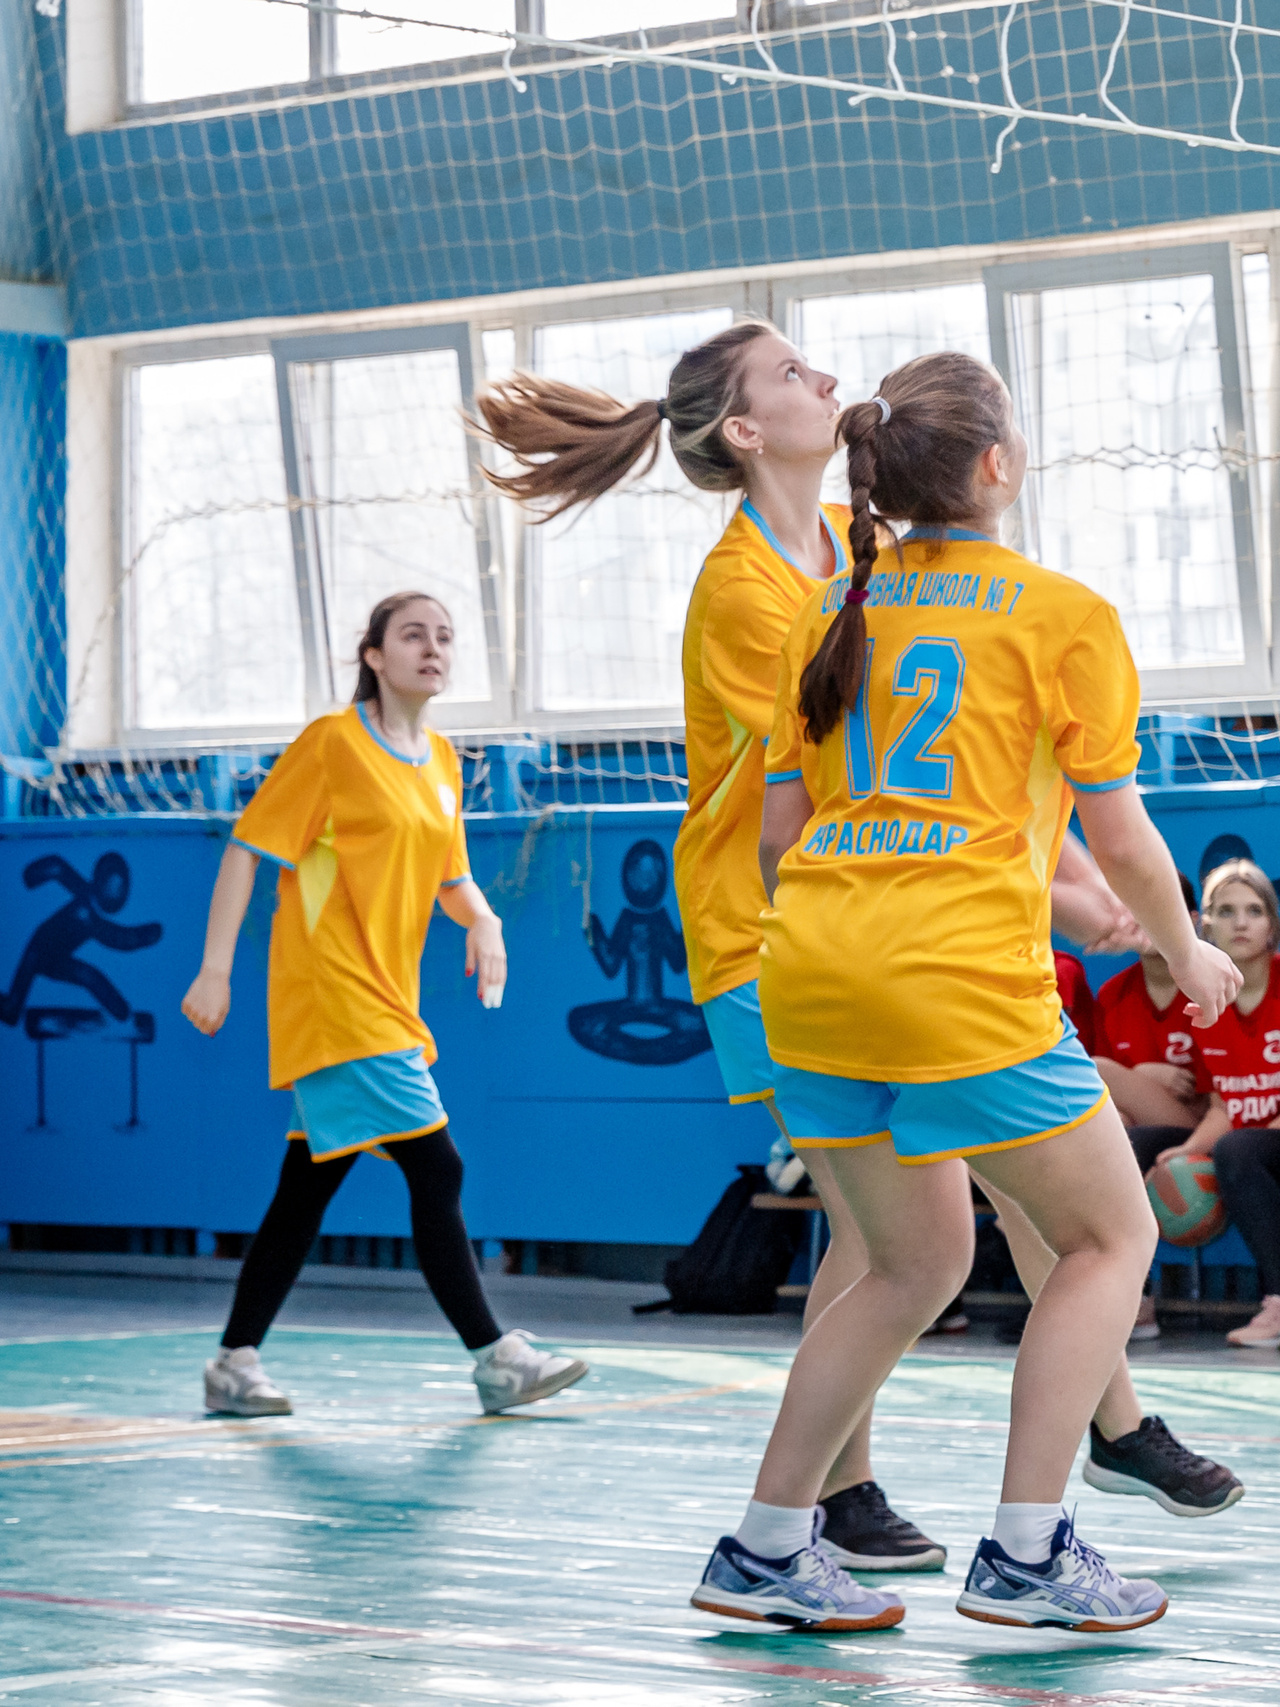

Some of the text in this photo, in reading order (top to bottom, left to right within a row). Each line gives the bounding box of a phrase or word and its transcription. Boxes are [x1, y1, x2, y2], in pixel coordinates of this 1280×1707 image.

[915, 571, 982, 609] ШКОЛА
[1007, 582, 1025, 616] 7
[843, 635, 966, 800] 12
[803, 819, 968, 856] КРАСНОДАР
